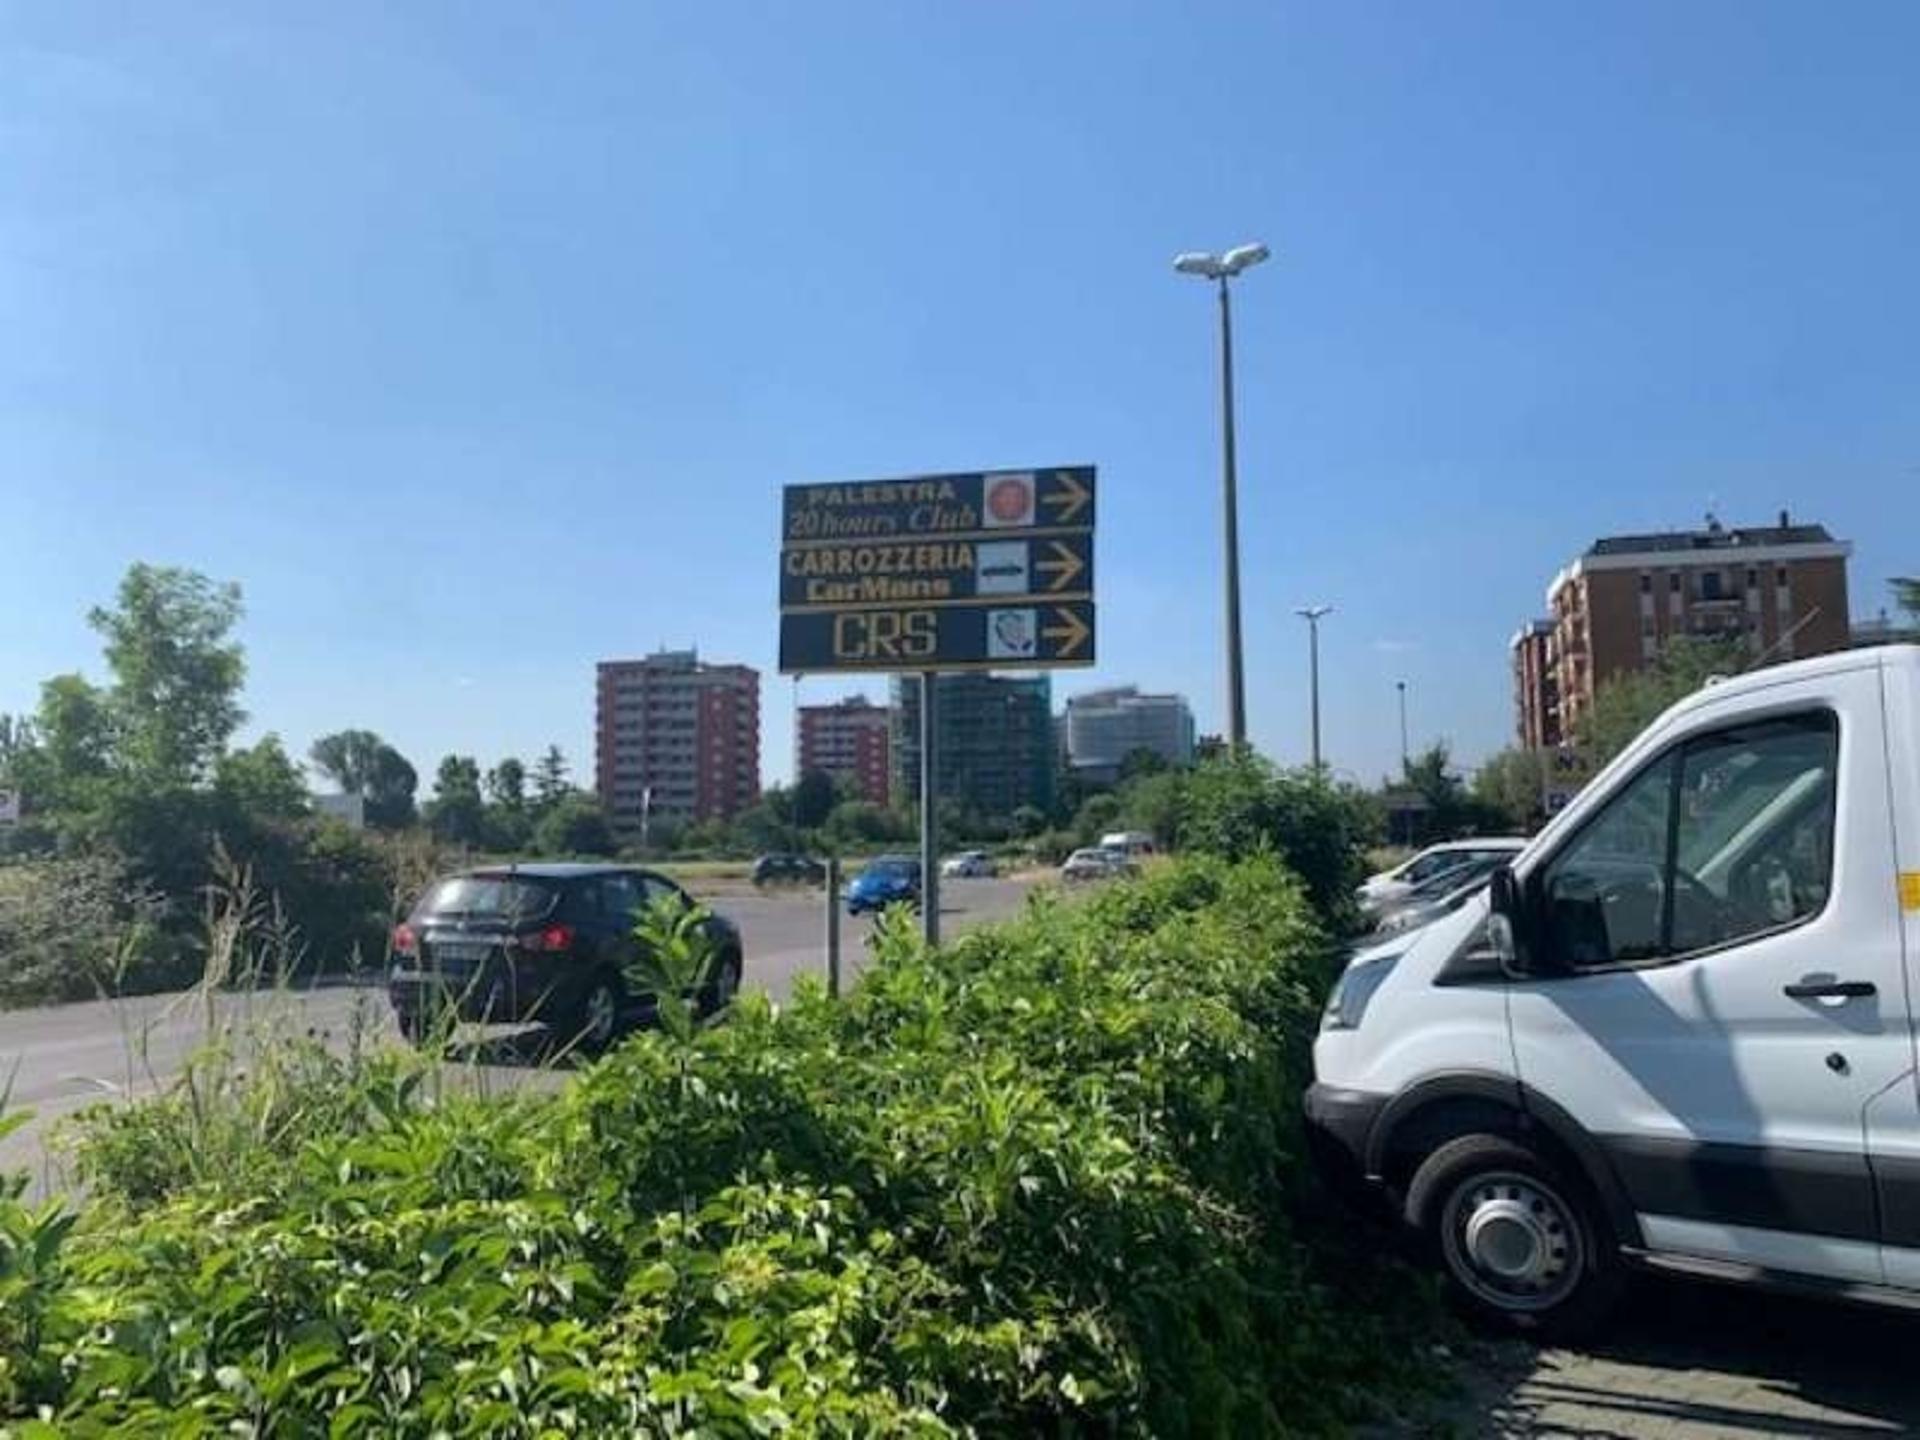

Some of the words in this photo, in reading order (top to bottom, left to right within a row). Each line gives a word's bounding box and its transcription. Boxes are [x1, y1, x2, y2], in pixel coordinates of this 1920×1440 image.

[808, 482, 955, 506] PALESTRA
[909, 504, 976, 531] Club
[786, 544, 973, 576] CARROZZERIA
[834, 611, 938, 658] CRS
